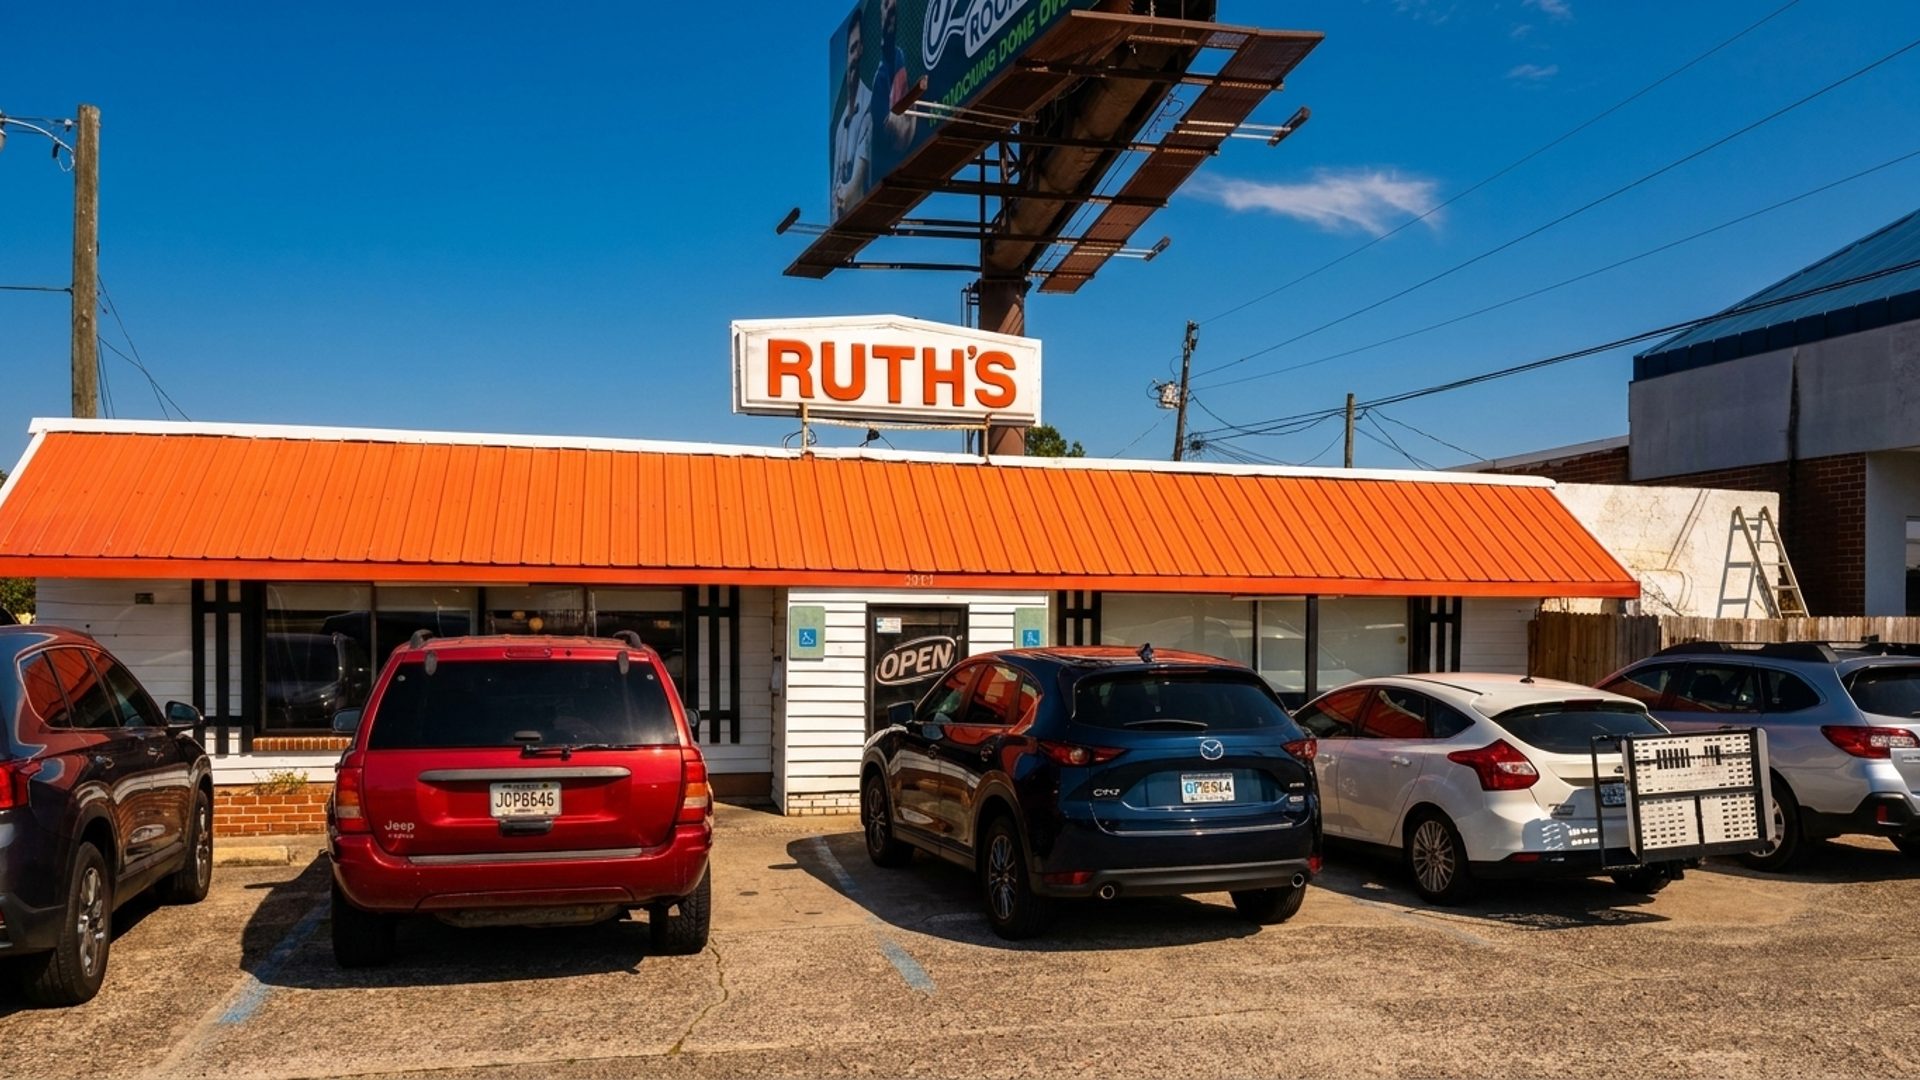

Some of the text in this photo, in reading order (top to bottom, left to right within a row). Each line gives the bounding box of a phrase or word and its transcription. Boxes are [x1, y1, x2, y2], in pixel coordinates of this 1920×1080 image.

[999, 9, 1035, 62] DONE
[768, 338, 1017, 408] RUTH'S
[880, 643, 952, 679] OPEN
[384, 819, 415, 832] Jeep
